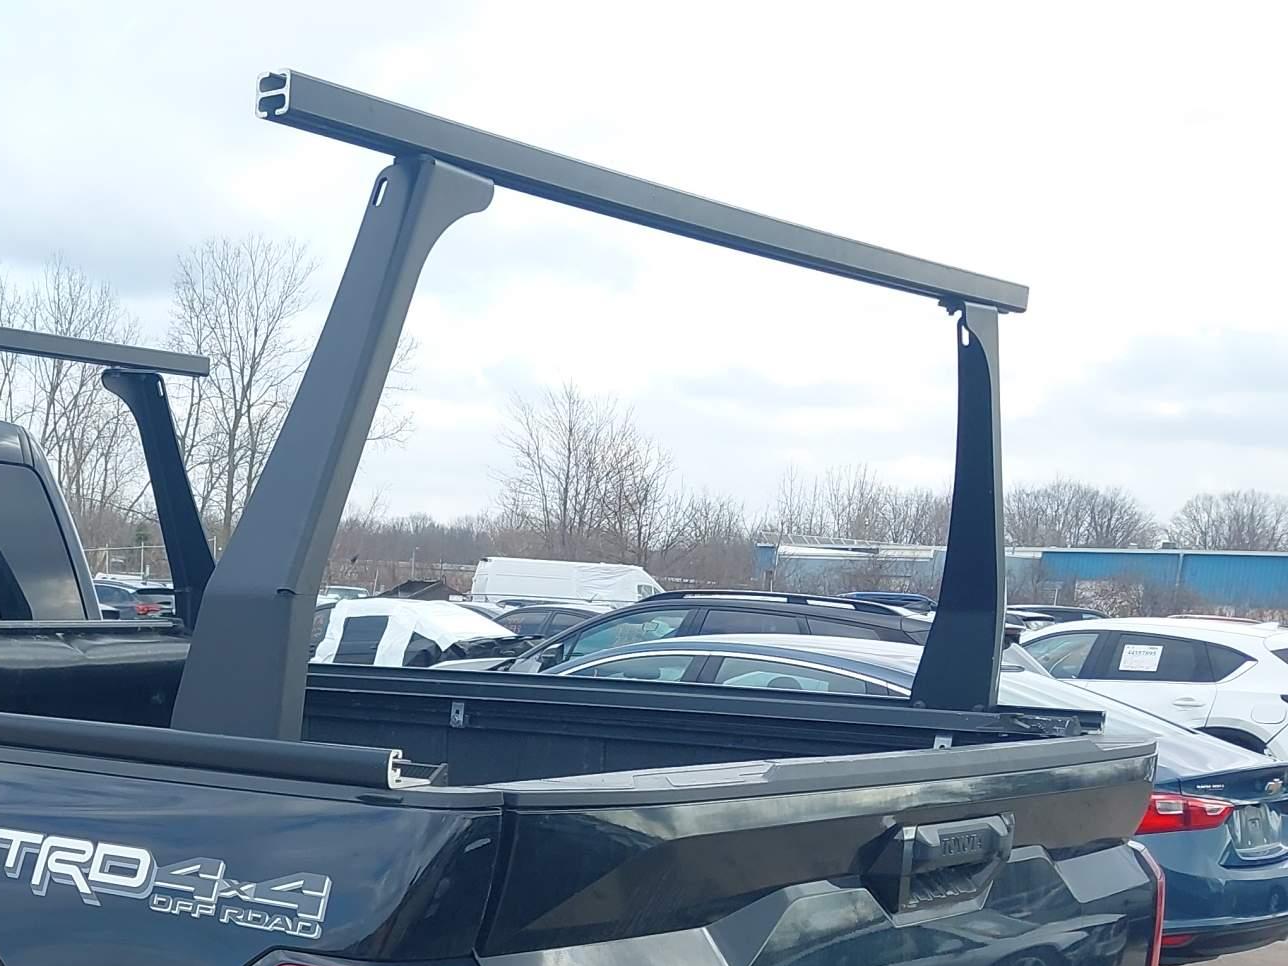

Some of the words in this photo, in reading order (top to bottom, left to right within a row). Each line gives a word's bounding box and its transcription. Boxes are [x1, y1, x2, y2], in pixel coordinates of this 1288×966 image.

[149, 893, 216, 918] OFF
[219, 905, 323, 939] ROAD
[153, 856, 333, 923] 4x4
